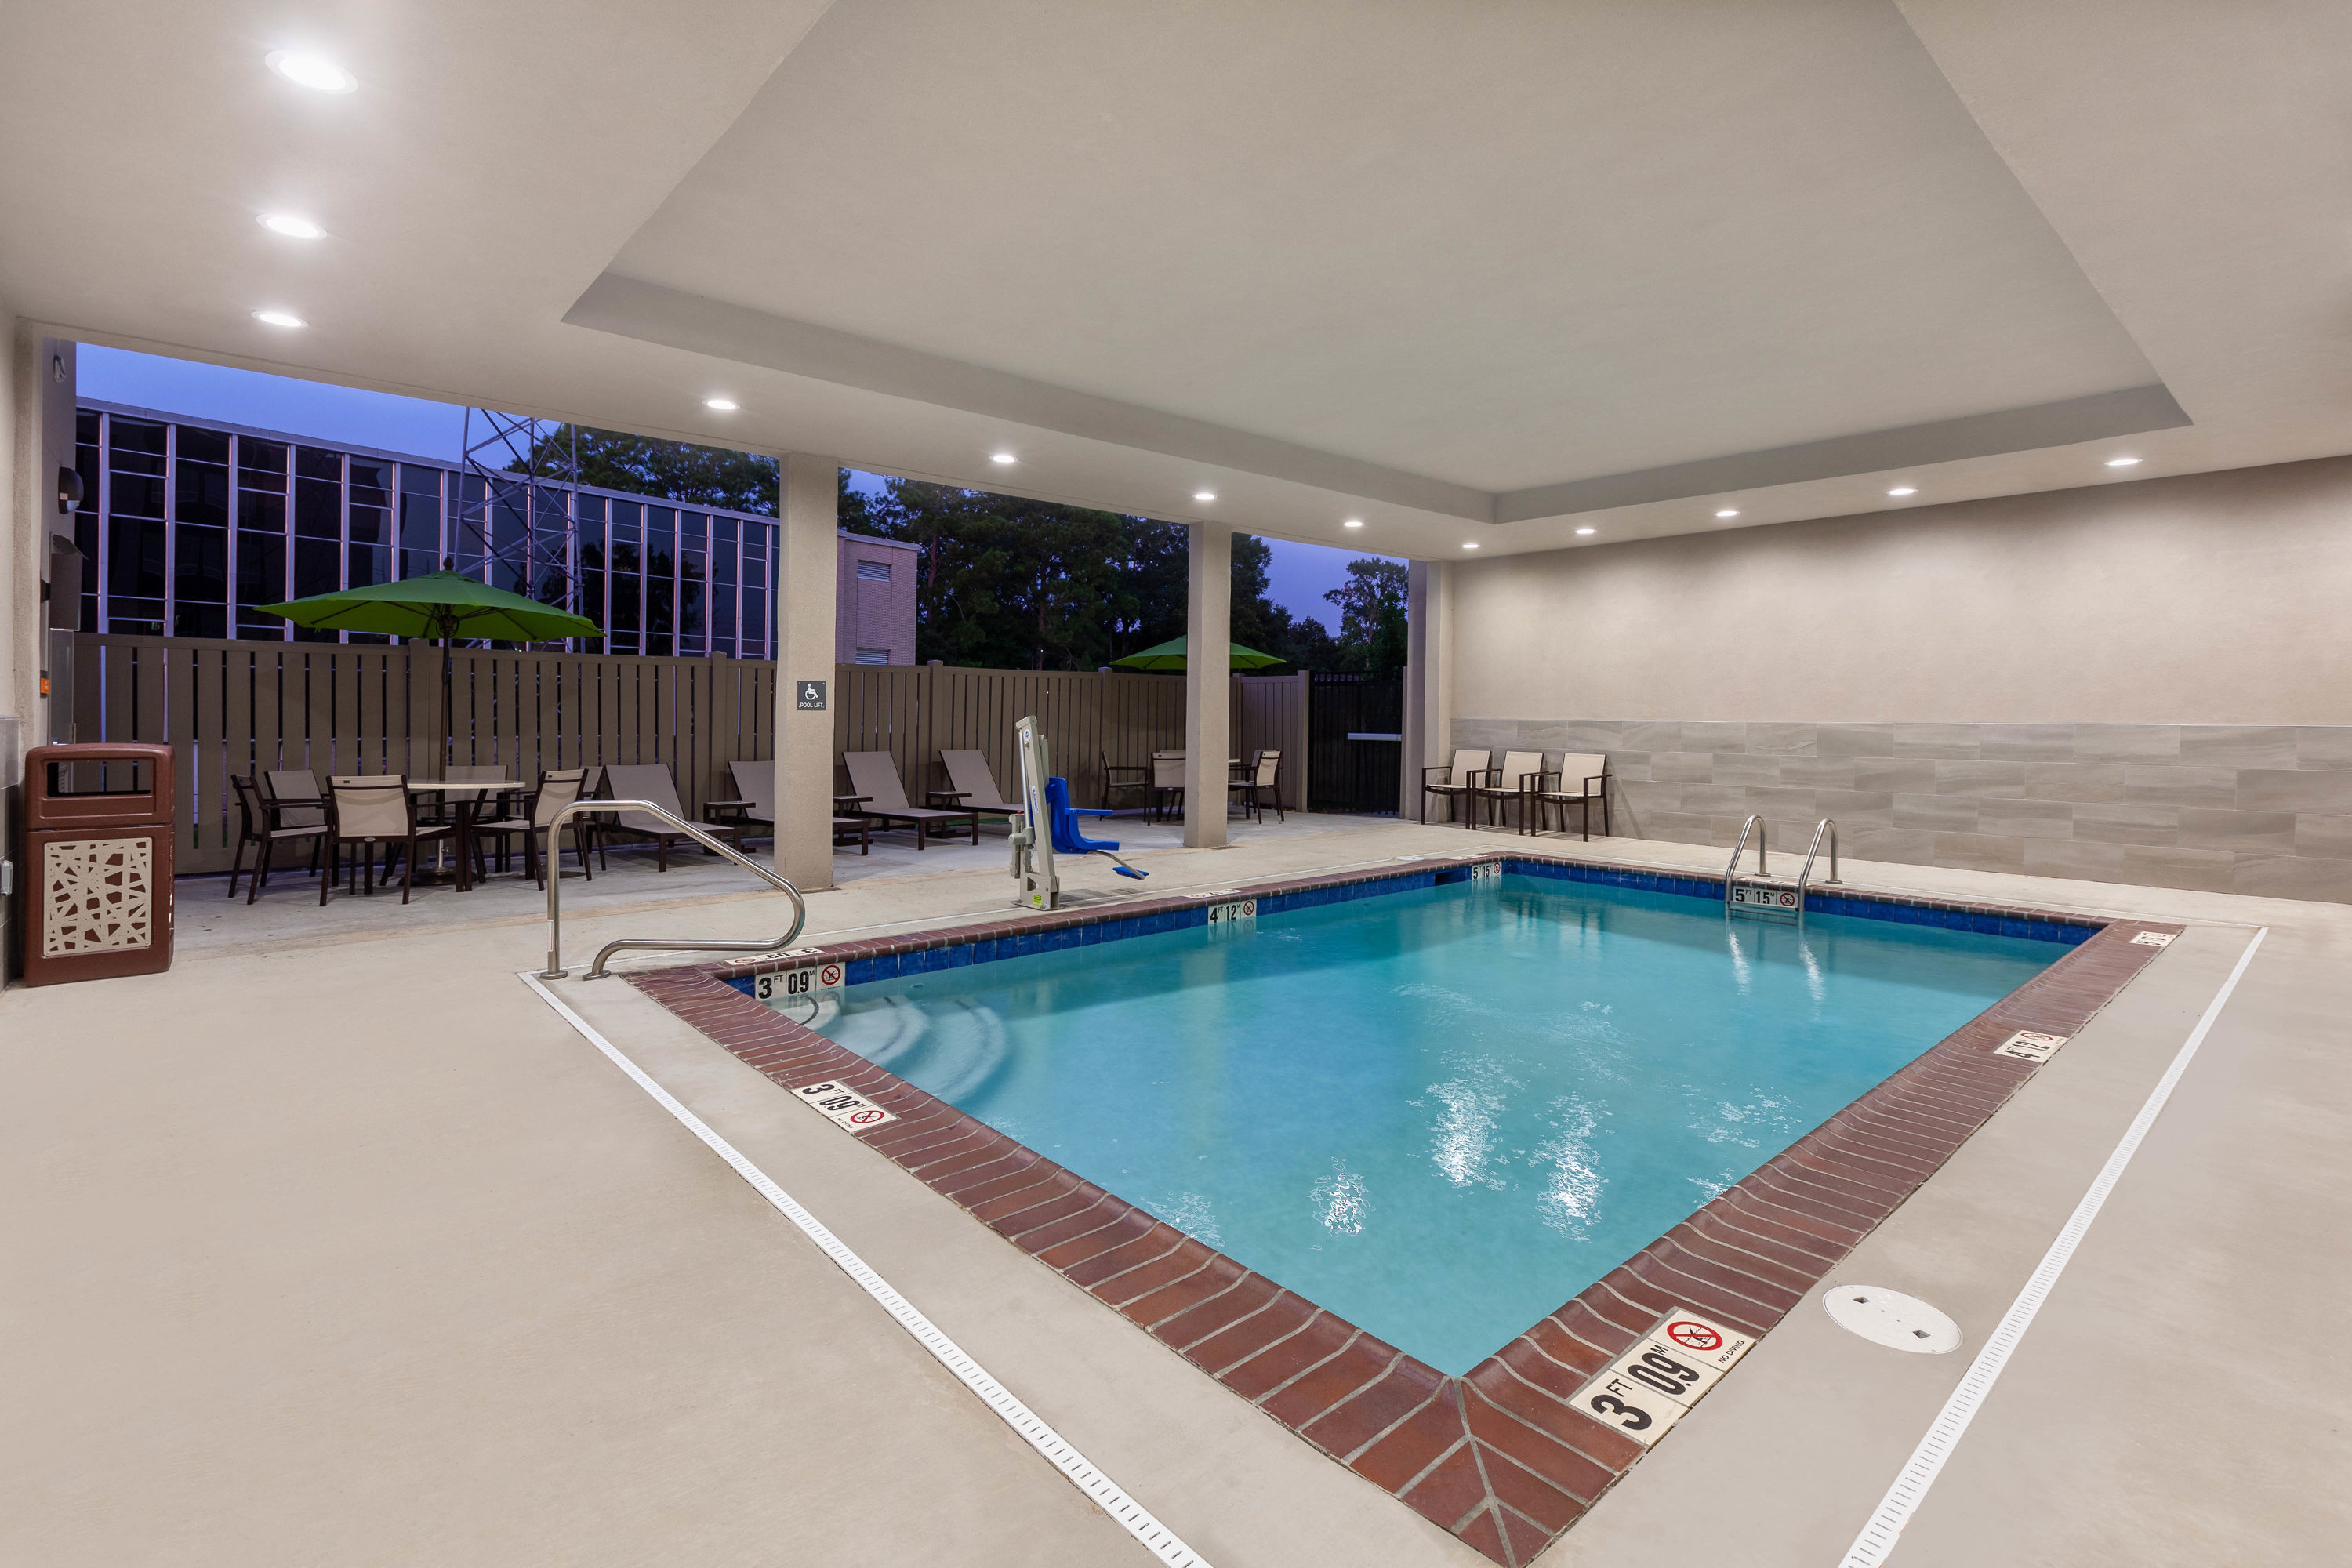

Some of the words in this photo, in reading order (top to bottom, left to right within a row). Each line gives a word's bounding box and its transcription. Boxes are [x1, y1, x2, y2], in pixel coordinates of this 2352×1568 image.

[1473, 866, 1479, 879] 5
[1735, 888, 1745, 902] 5
[1210, 907, 1218, 924] 4
[758, 977, 772, 1000] 3
[774, 975, 783, 983] FT
[802, 1083, 836, 1094] 3
[1650, 1344, 1669, 1356] M
[1718, 1354, 1730, 1363] NO
[1726, 1339, 1745, 1356] DIVING
[1605, 1378, 1633, 1398] FT
[1590, 1394, 1653, 1431] 3
